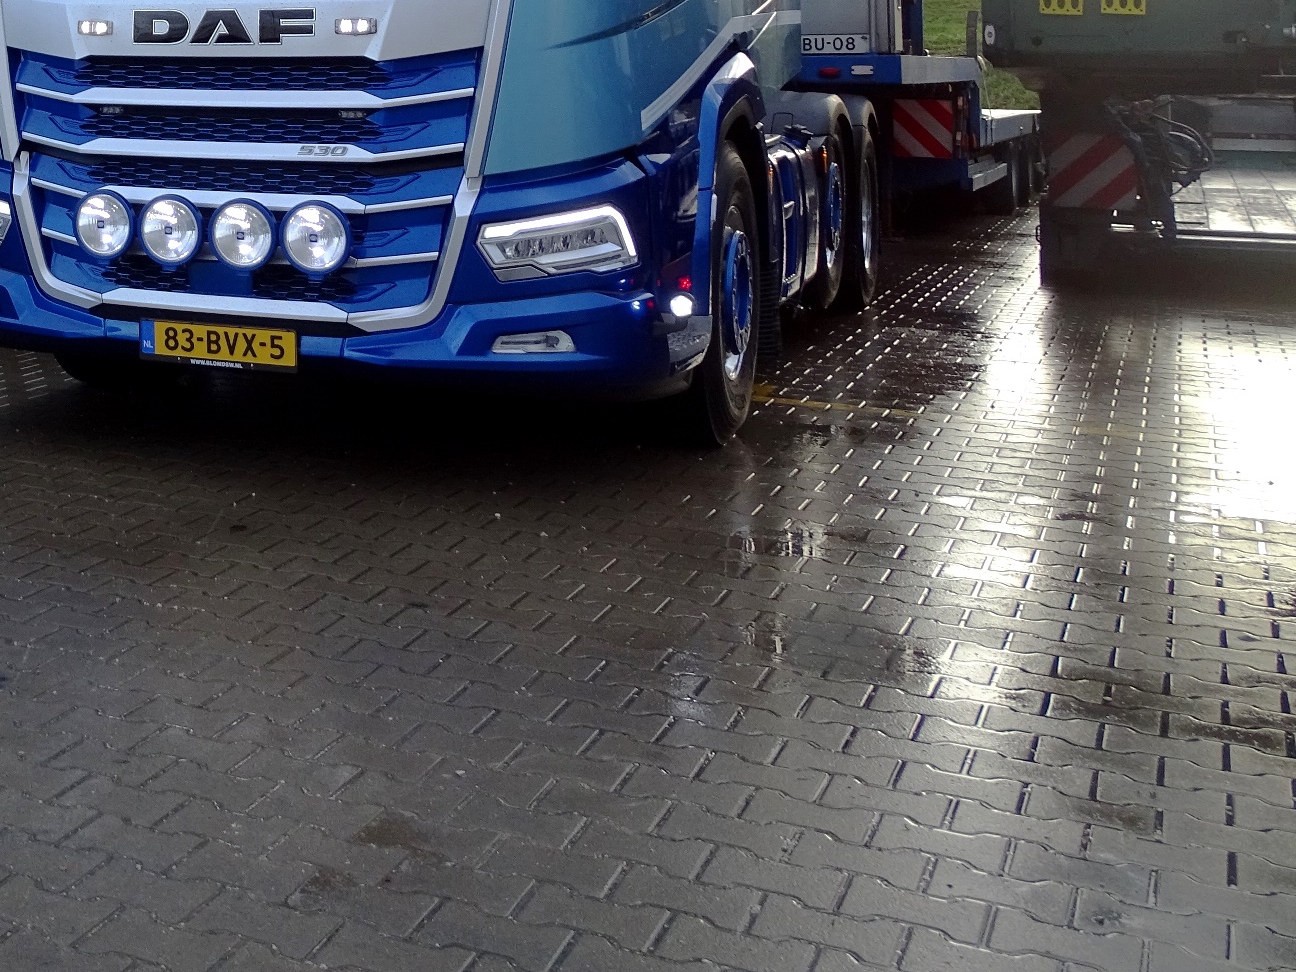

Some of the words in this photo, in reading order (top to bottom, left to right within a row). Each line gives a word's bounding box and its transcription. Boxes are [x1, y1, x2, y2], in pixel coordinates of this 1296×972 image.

[132, 7, 317, 46] DAF
[802, 36, 856, 51] BU-08
[297, 145, 349, 157] 530
[143, 339, 154, 349] NL
[164, 326, 285, 360] 83-BVX-5
